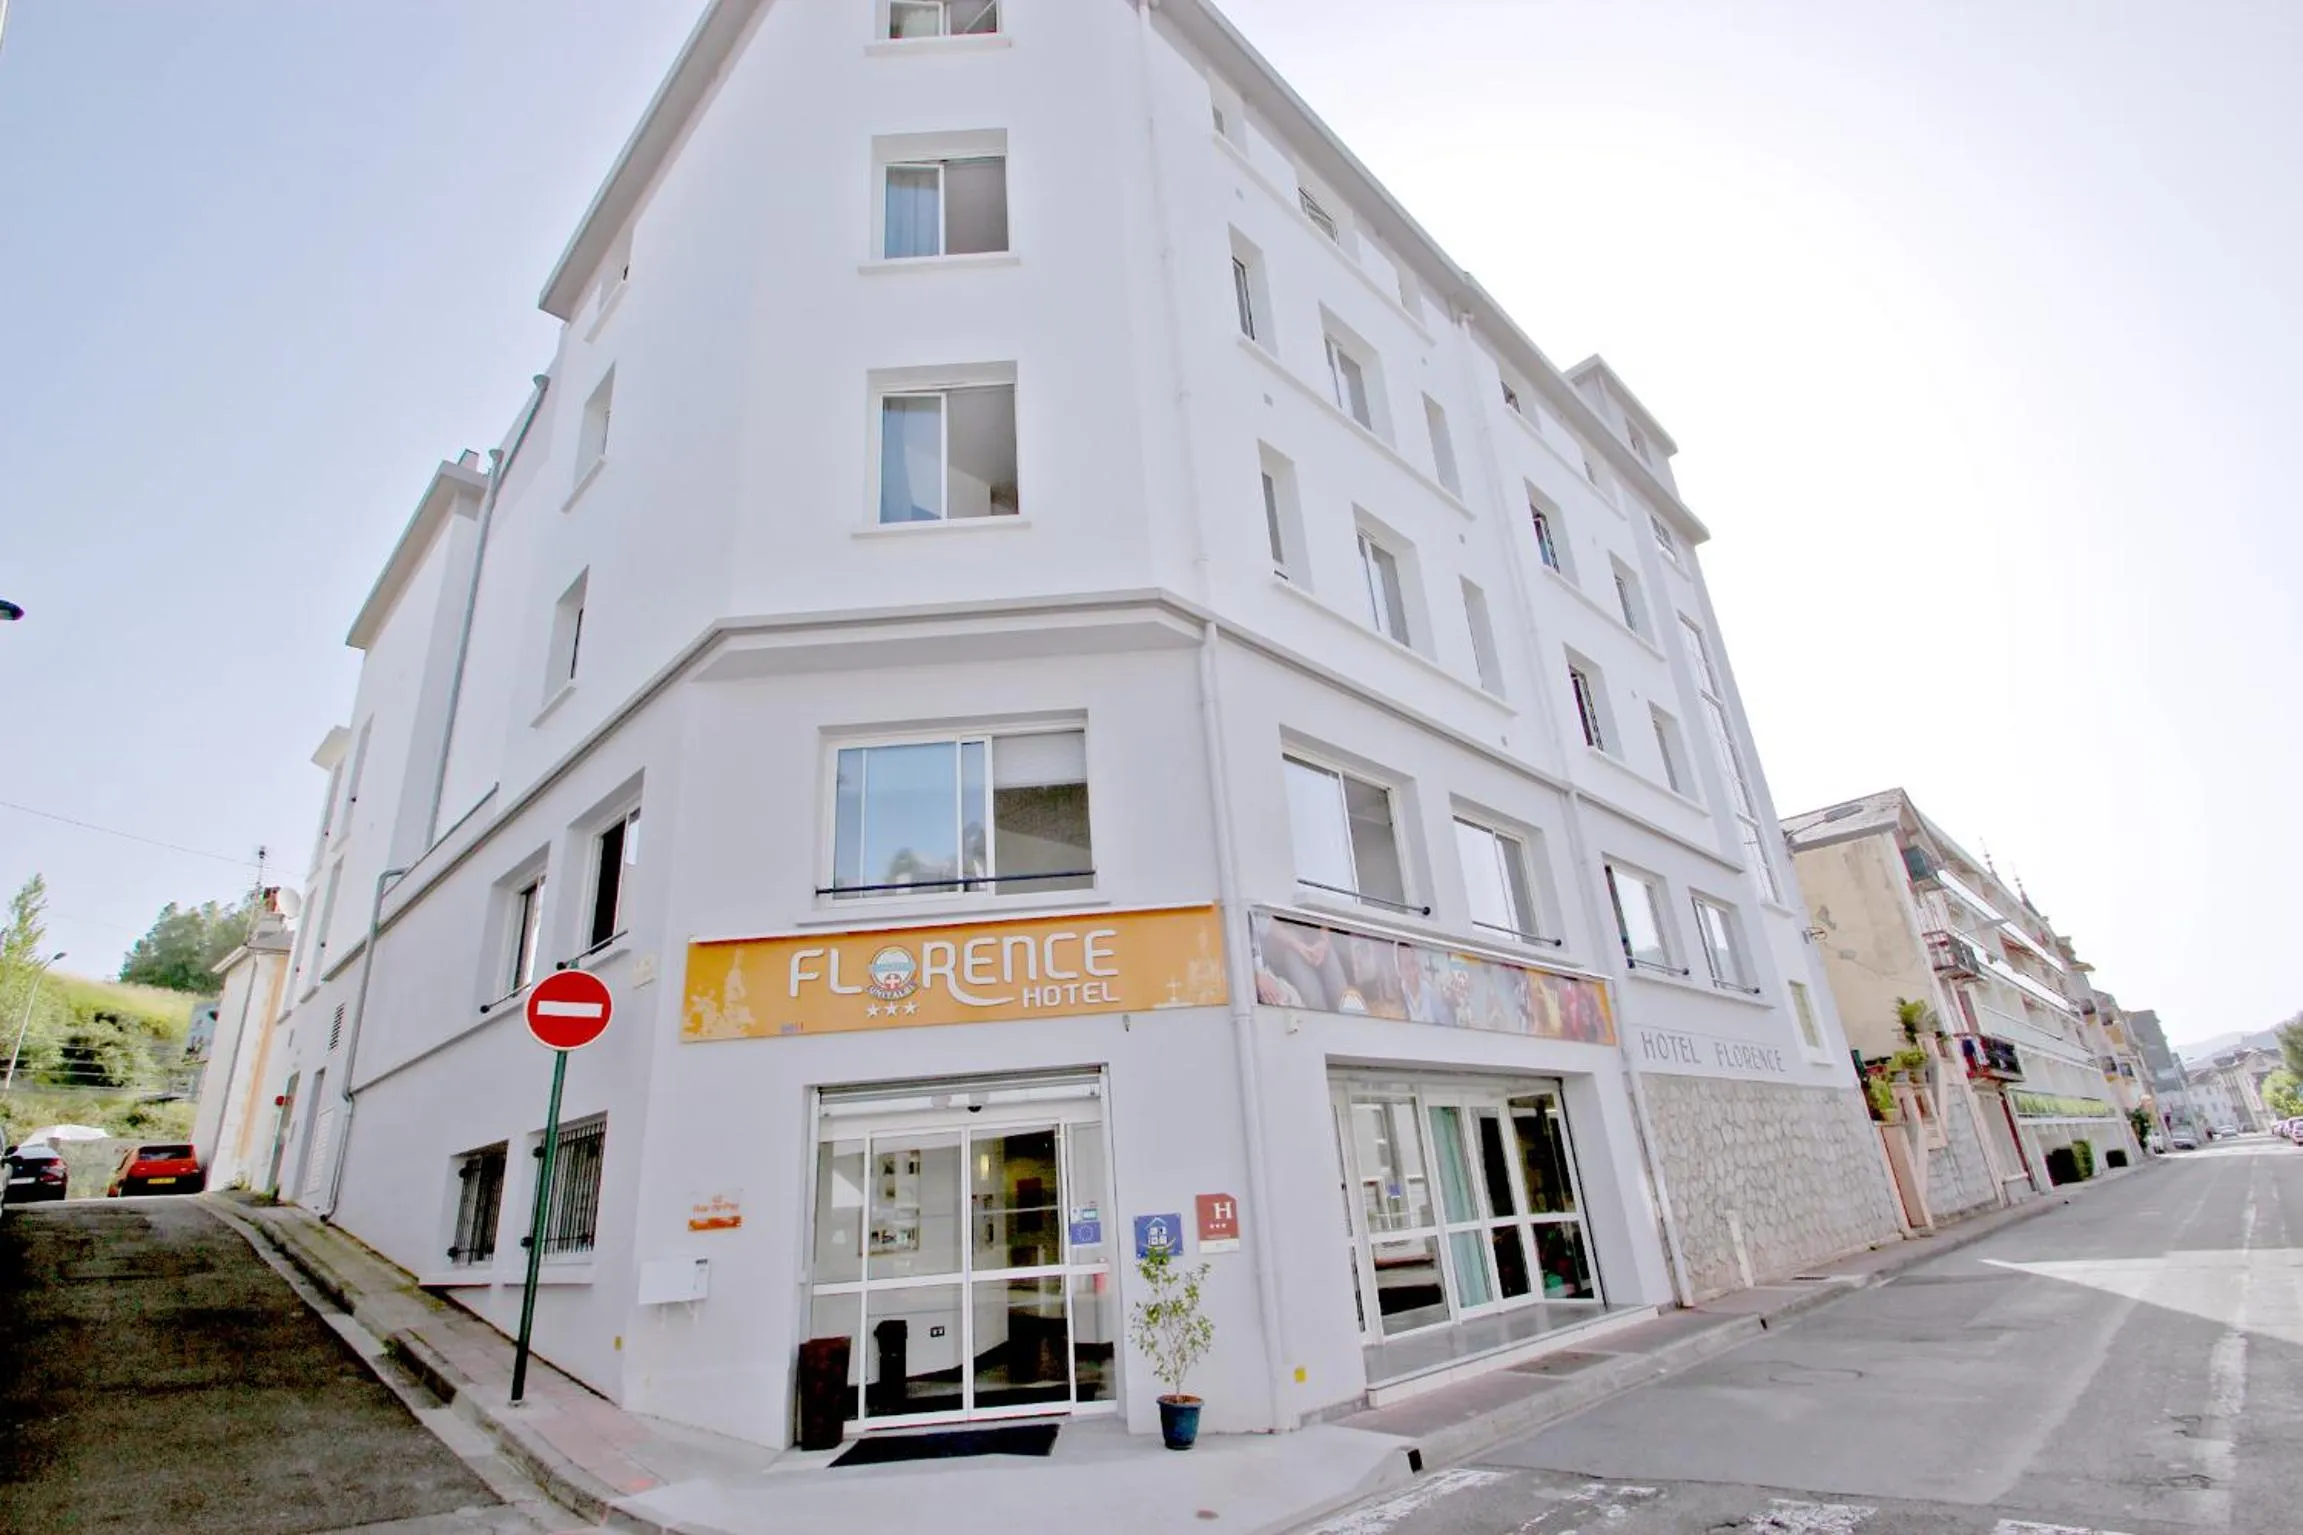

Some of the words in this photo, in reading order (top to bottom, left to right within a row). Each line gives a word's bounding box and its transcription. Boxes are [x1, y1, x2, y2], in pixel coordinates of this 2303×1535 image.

[1022, 982, 1120, 1008] HOTEL
[1640, 1031, 1702, 1064] HOTEL
[1713, 1041, 1787, 1073] FLORENCE
[1213, 1201, 1232, 1220] H
